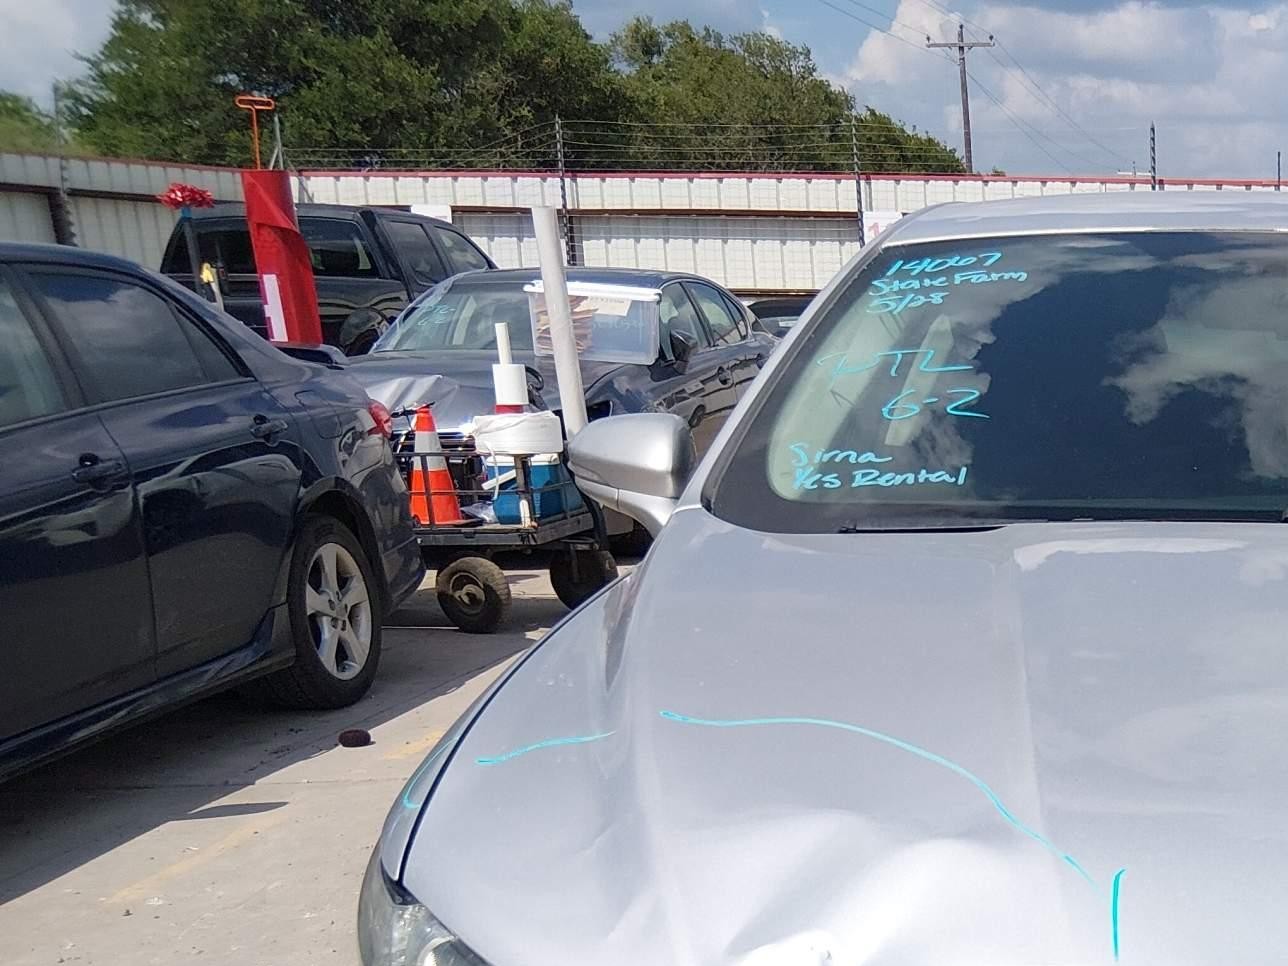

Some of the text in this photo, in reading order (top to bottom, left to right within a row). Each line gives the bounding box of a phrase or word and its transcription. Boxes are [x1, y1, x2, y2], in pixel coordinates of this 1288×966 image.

[954, 270, 1029, 285] Farm
[881, 388, 990, 420] 6-2
[850, 466, 968, 488] Rental
